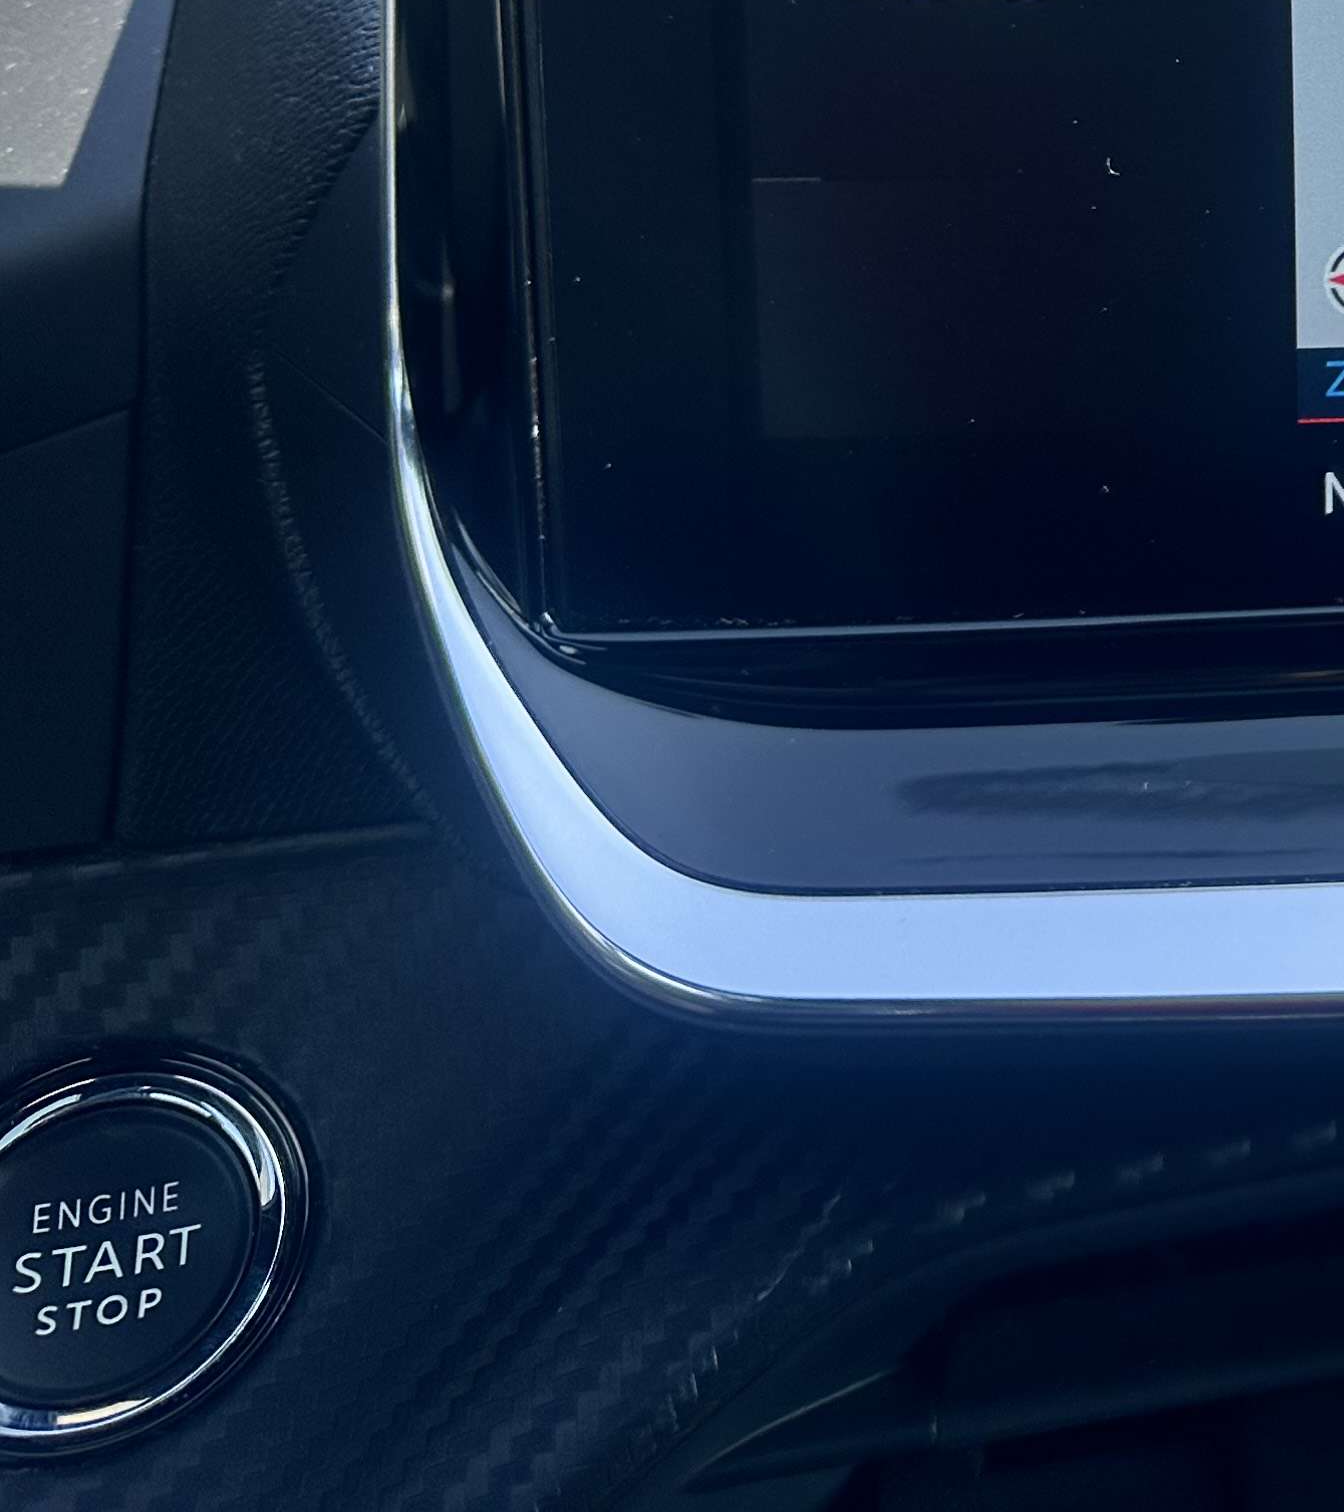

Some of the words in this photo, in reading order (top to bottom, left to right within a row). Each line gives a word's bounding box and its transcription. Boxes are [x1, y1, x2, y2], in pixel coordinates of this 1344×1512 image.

[32, 1180, 181, 1234] ENGINE
[12, 1223, 202, 1295] START
[34, 1287, 163, 1336] STOP
